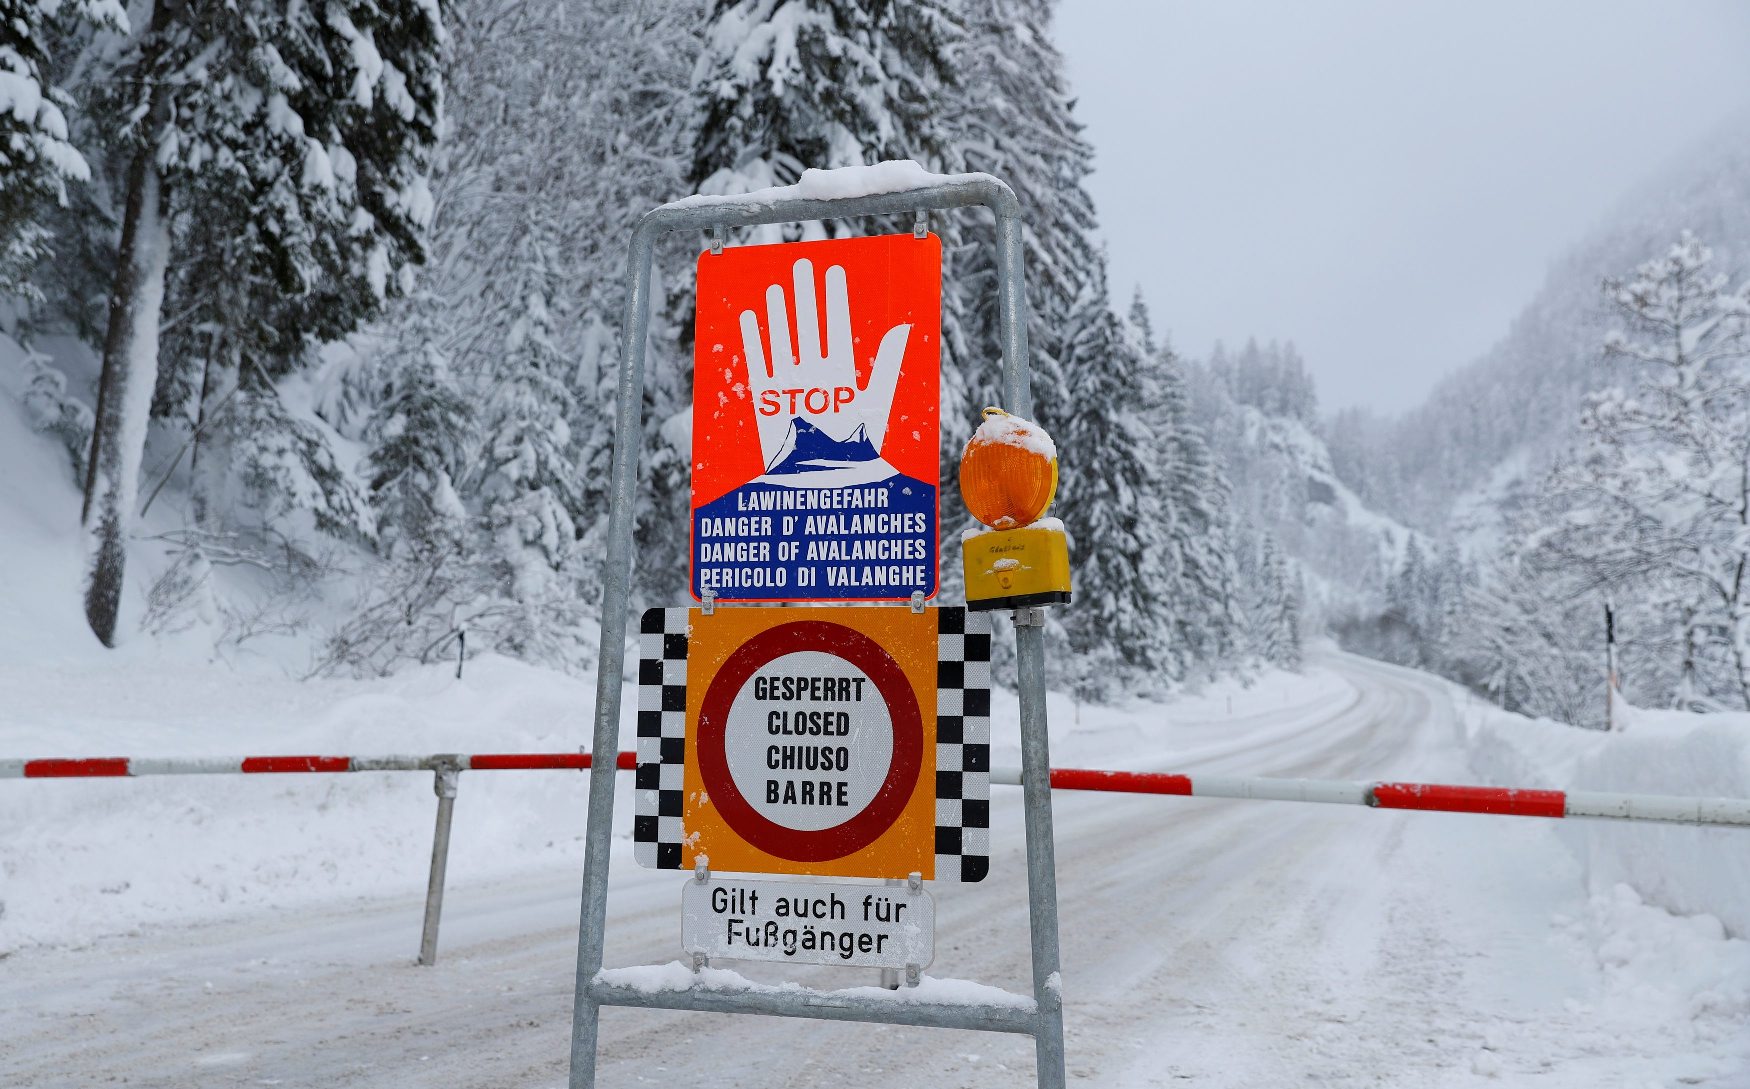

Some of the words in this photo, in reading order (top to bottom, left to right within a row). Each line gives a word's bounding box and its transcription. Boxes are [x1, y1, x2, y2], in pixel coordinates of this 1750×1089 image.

[758, 386, 856, 416] STOP
[737, 488, 889, 511] LAWINENGEFAHR
[701, 515, 772, 538] DANGER
[804, 513, 927, 535] AVALANCHES
[700, 542, 770, 562] DANGER
[778, 541, 800, 561] OF
[806, 539, 927, 561] AVALANCHES
[700, 567, 787, 588] PERICOLO
[797, 567, 816, 587] DI
[827, 565, 926, 586] VALANGHE
[754, 676, 866, 702] GESPERRT
[767, 710, 850, 736] CLOSED
[766, 745, 849, 771] CHIUSO
[766, 780, 849, 806] BARRE
[711, 887, 759, 915] Gilt
[775, 893, 845, 919] auch
[863, 894, 907, 922] für
[727, 919, 889, 959] Fußgänger
